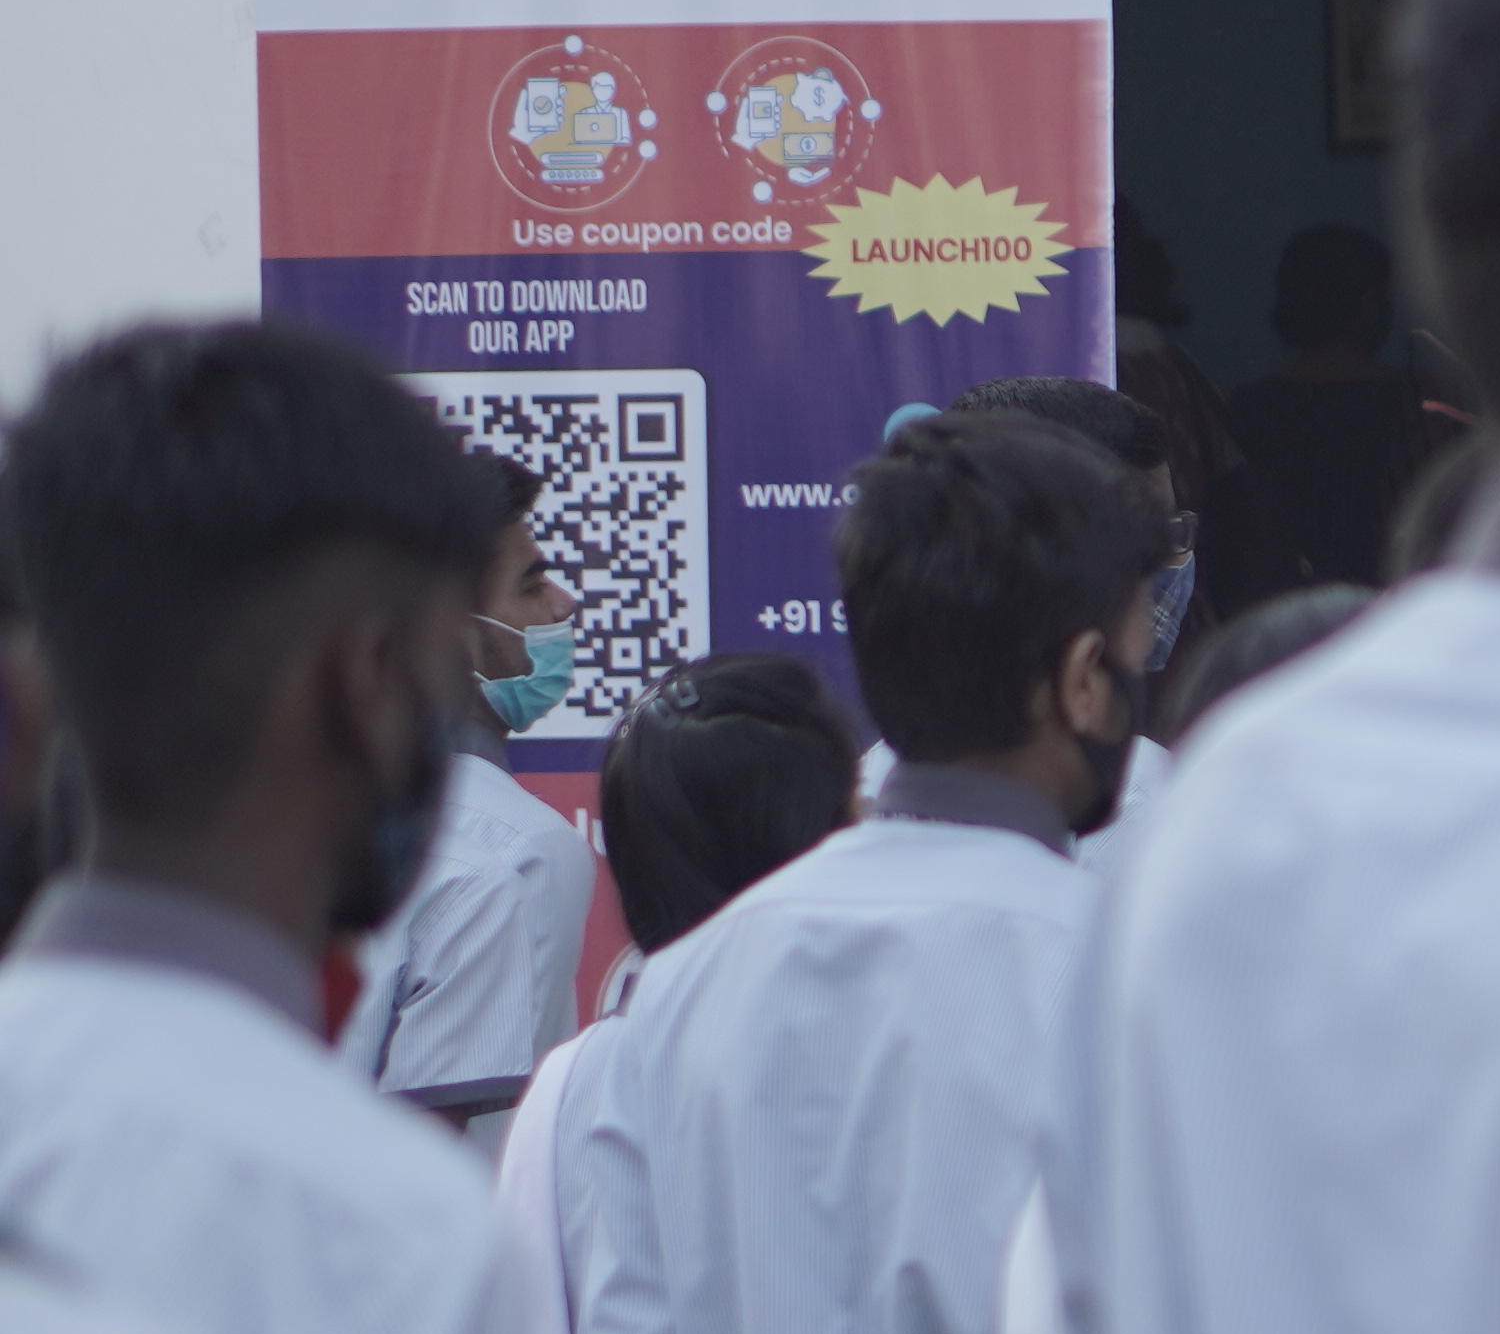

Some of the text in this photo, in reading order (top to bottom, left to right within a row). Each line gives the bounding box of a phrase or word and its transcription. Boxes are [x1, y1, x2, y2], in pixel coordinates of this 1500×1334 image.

[514, 216, 793, 254] Use coupon code
[852, 236, 1033, 265] LAUNCH100
[407, 278, 648, 316] SCAN TO DOWNLOAD
[469, 319, 575, 355] OUR APP
[757, 599, 821, 634] +91
